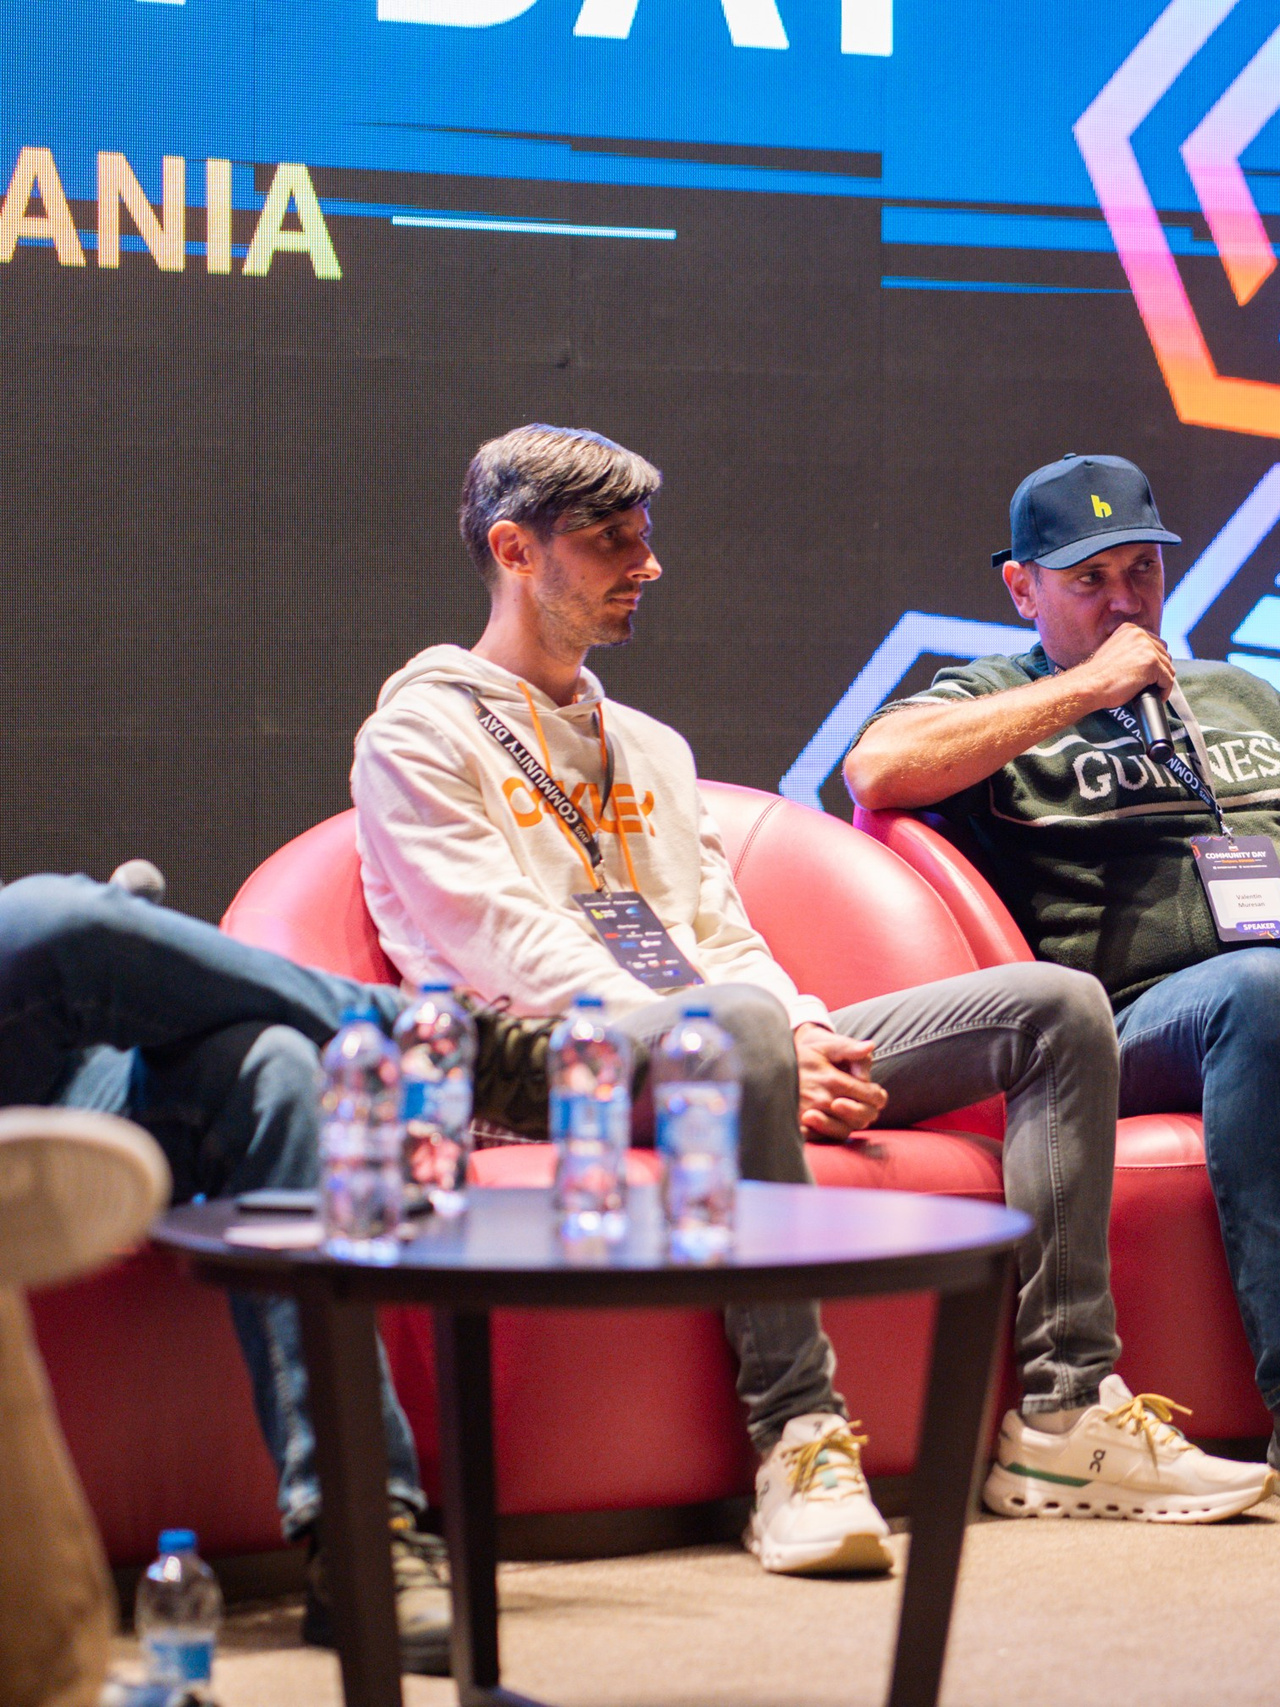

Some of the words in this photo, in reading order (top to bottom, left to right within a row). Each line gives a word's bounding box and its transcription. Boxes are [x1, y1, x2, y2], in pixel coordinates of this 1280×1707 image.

[480, 713, 511, 742] DAY
[1109, 706, 1136, 729] DAY
[505, 739, 579, 824] COMMUNITY
[1205, 851, 1251, 859] COMMUNITY
[1243, 922, 1276, 931] SPEAKER
